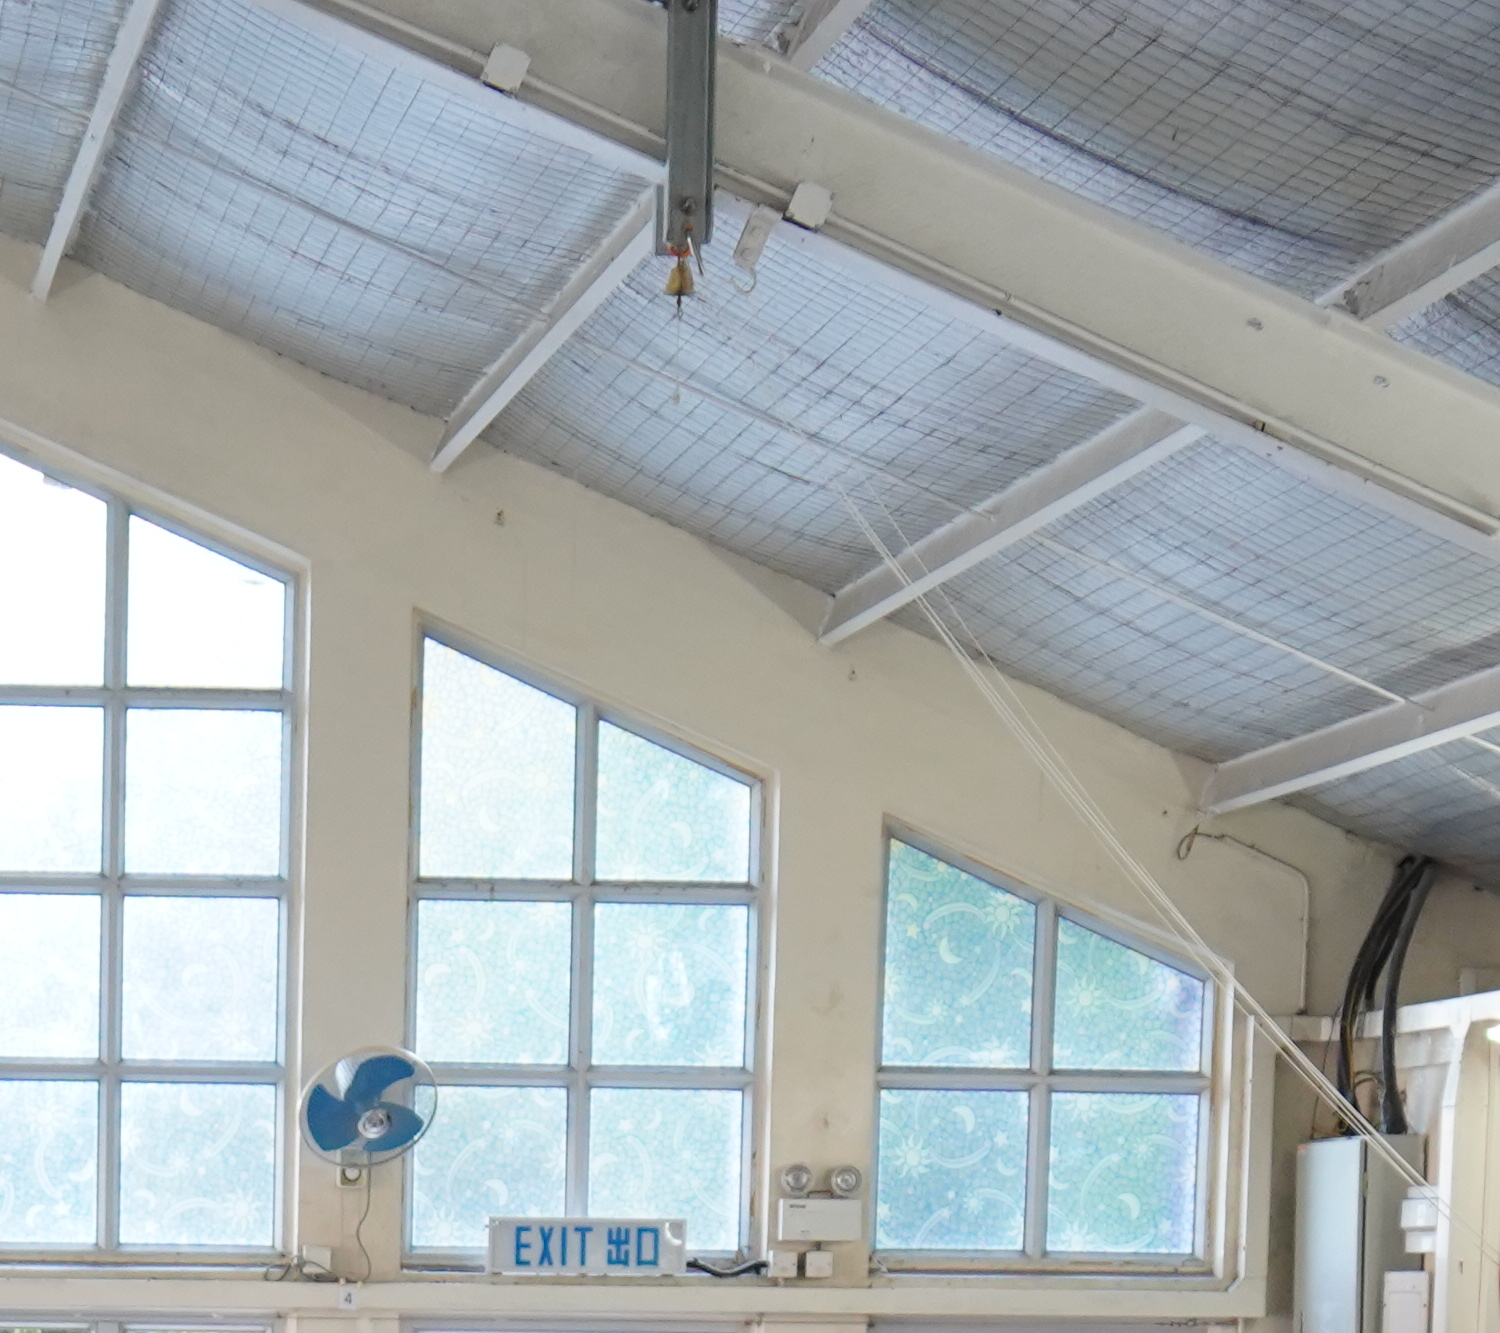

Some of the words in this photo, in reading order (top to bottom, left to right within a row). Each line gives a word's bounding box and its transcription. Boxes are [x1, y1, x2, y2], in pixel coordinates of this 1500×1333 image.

[514, 1226, 593, 1268] EXIT
[606, 1226, 660, 1268] 出口
[344, 1292, 353, 1306] 4
